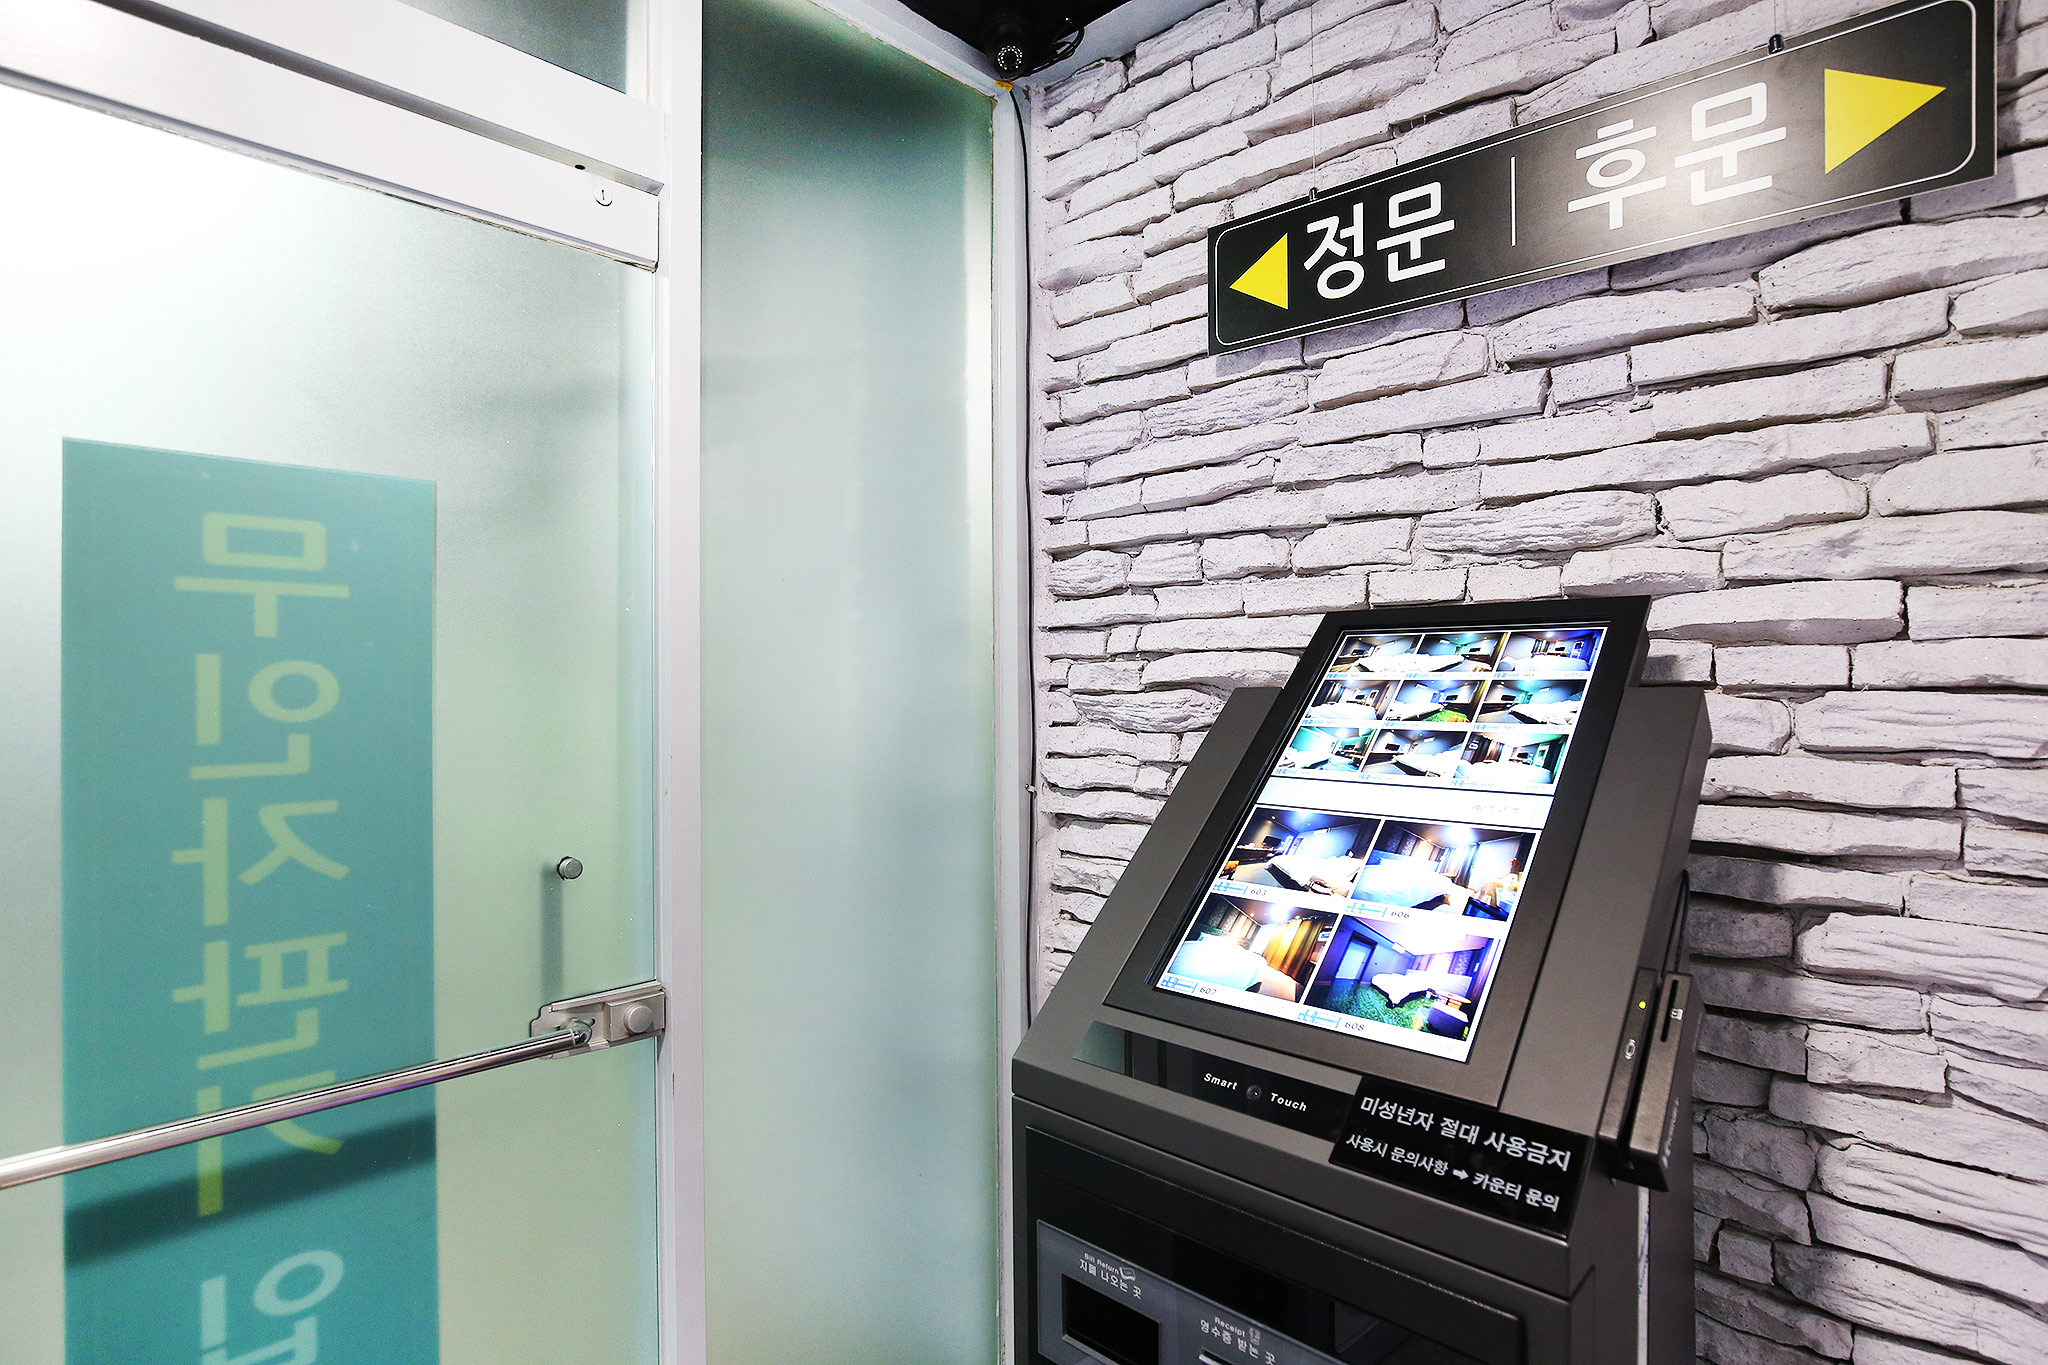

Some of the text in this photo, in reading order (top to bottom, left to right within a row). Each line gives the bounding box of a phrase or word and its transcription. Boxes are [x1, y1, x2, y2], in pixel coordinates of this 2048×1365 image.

[1567, 81, 1786, 231] 후문
[1303, 181, 1456, 300] 정문
[1203, 1072, 1307, 1112] Smart Touch
[1360, 1096, 1571, 1172] 미성년자 절대 사용금지
[1345, 1133, 1560, 1213] 사용시 문의사항 카운터 문의
[1084, 1252, 1120, 1275] Bill Return
[1100, 1269, 1129, 1293] 나오는
[1200, 1319, 1232, 1345] 영수증
[1237, 1337, 1260, 1359] 받는
[1214, 1315, 1246, 1338] Receipt
